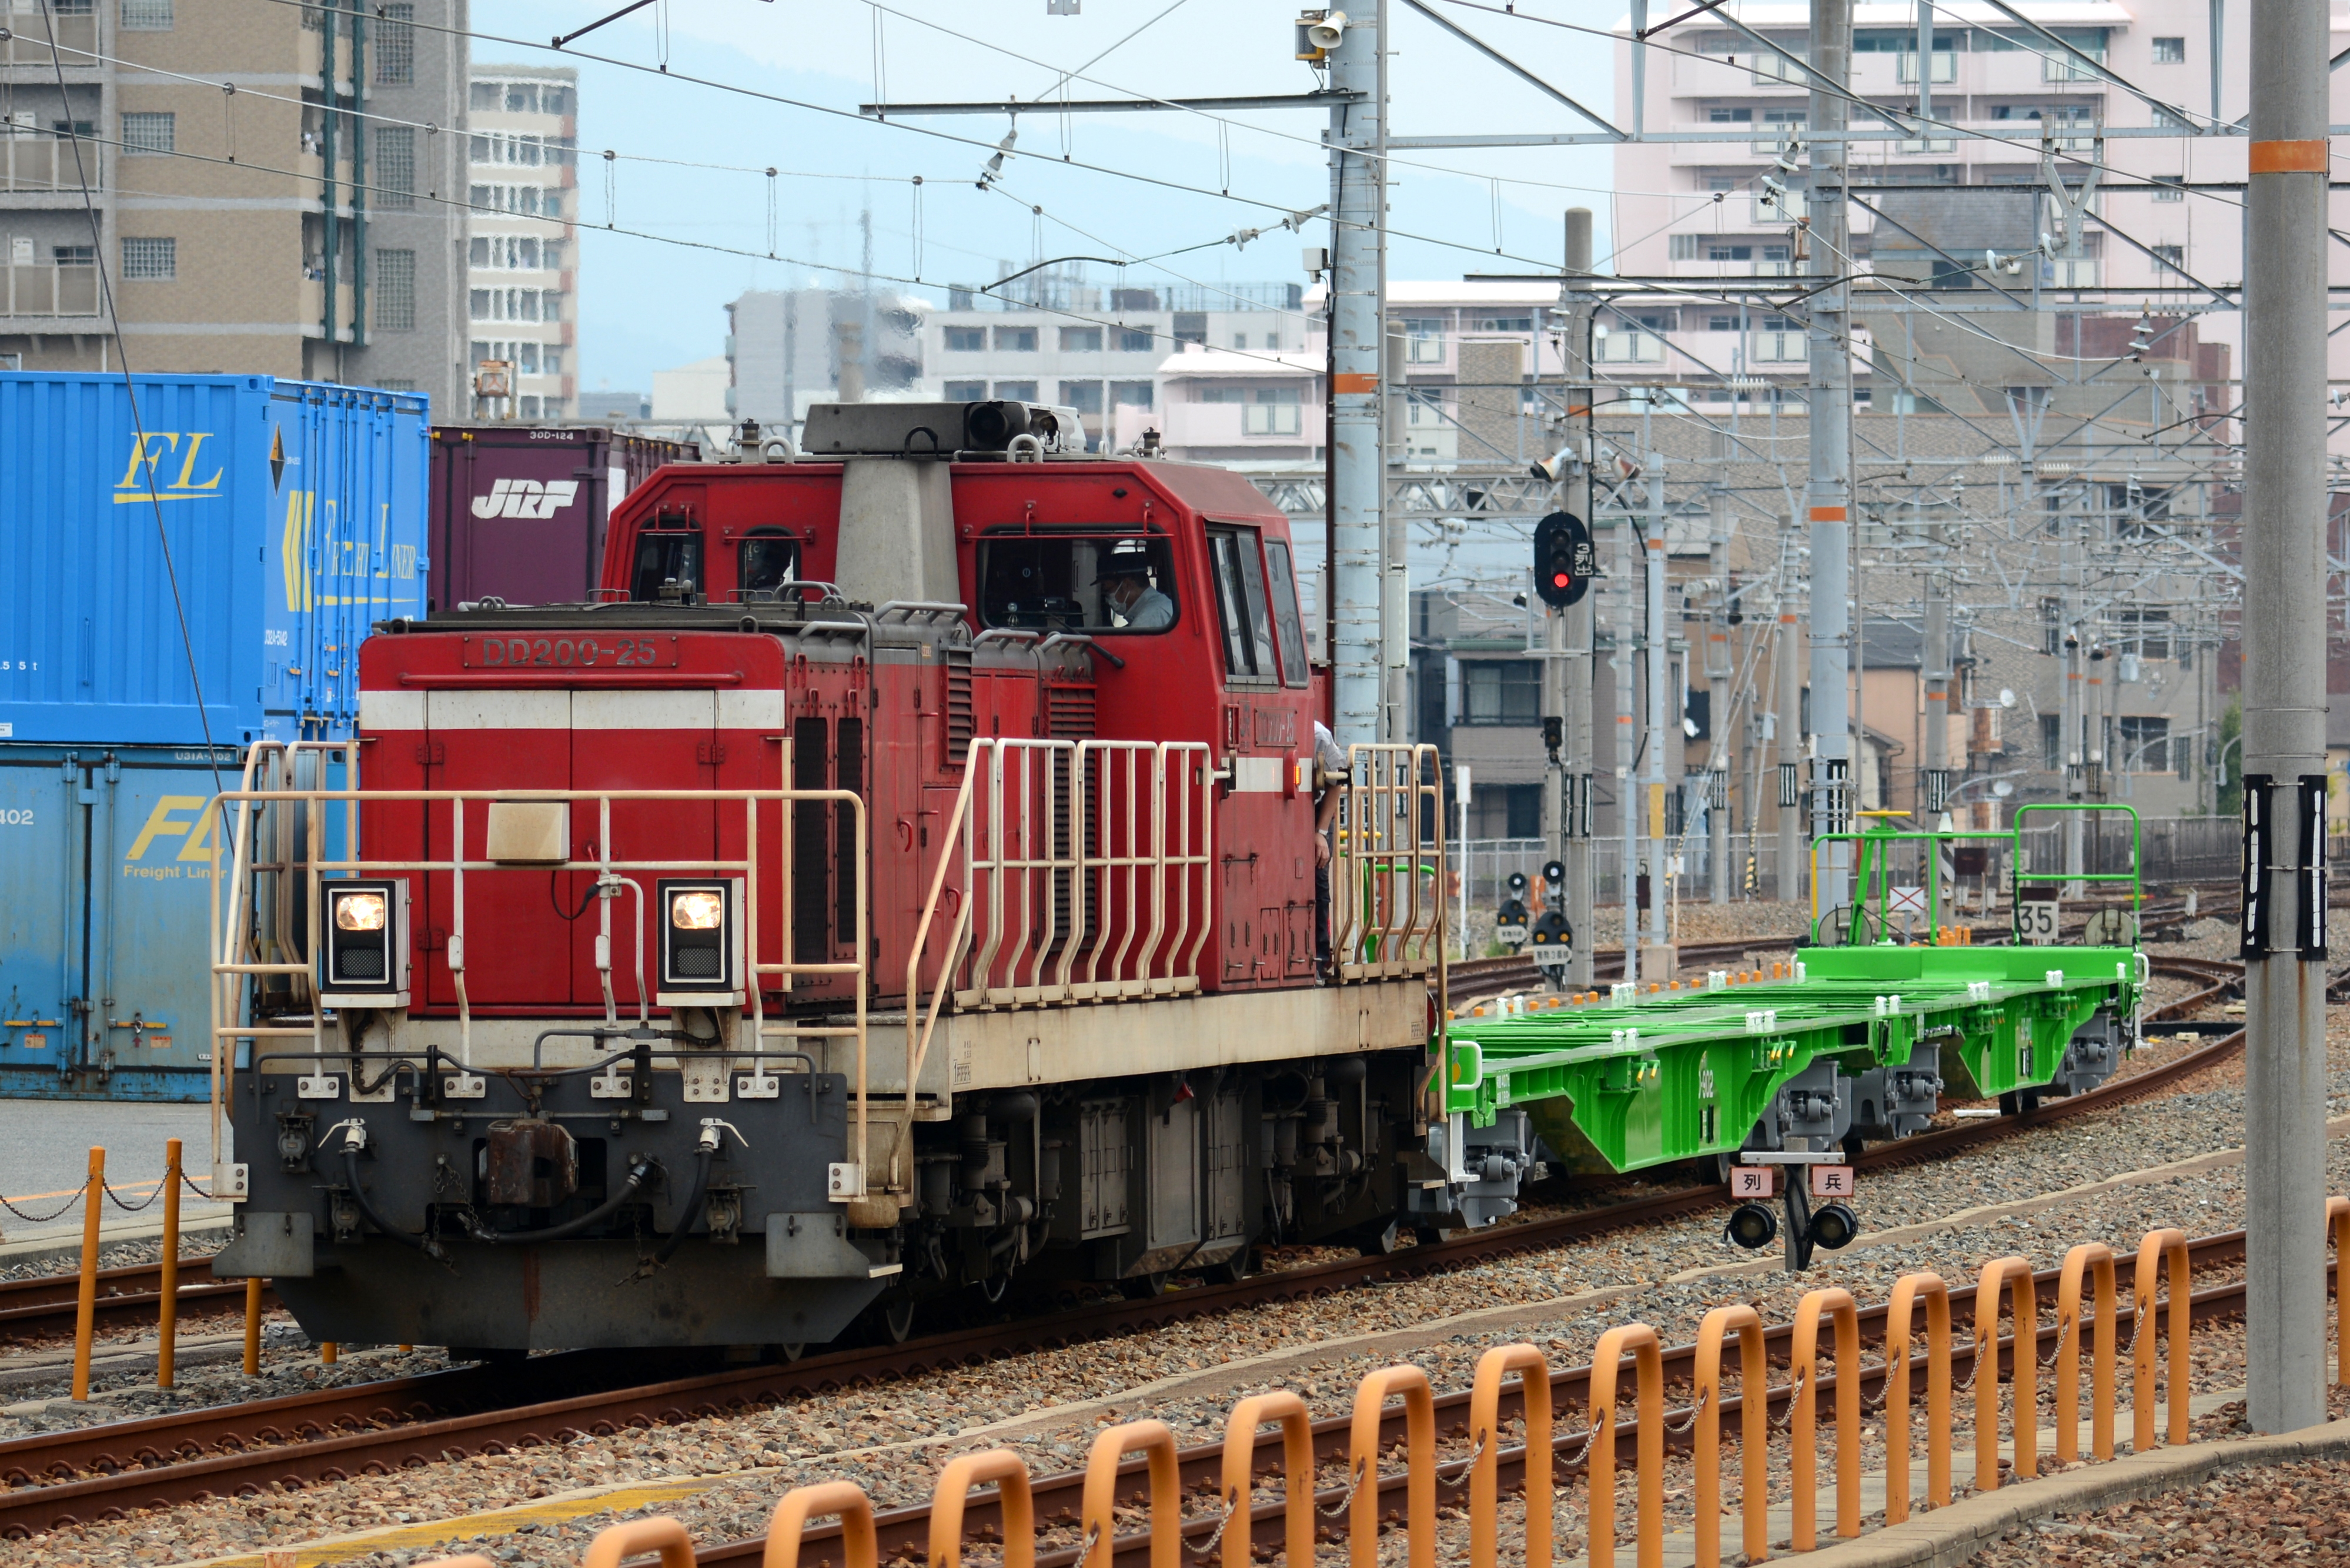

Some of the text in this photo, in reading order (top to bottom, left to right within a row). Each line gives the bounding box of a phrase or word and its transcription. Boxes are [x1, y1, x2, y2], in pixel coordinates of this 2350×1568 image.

[530, 431, 574, 440] 30D-124
[114, 432, 223, 489] FL
[472, 479, 579, 519] JRF
[483, 638, 656, 666] DD200-25
[125, 795, 225, 861] FL
[124, 865, 228, 881] Freight Linr
[2019, 906, 2053, 934] 35
[1699, 1069, 1714, 1099] -902
[1744, 1174, 1761, 1191] 列
[1825, 1174, 1841, 1190] 兵
